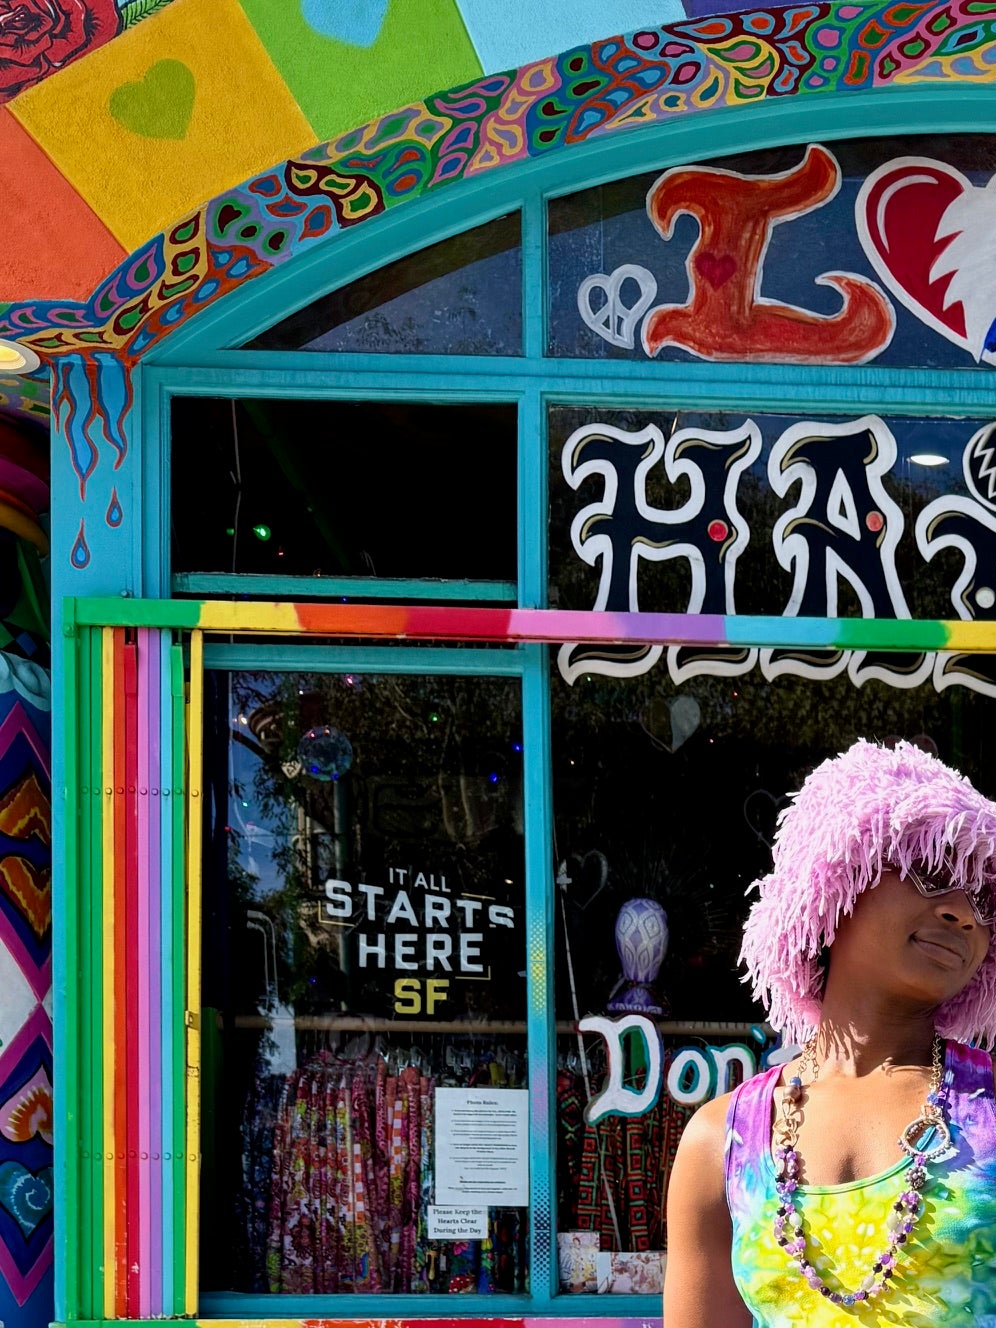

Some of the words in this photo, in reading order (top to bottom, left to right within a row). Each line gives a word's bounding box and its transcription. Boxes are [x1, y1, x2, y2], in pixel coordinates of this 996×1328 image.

[389, 867, 407, 885] IT
[414, 872, 451, 893] ALL
[324, 878, 515, 929] STARTS
[358, 932, 484, 973] HERE
[393, 978, 450, 1015] SF
[454, 1208, 471, 1216] Keep
